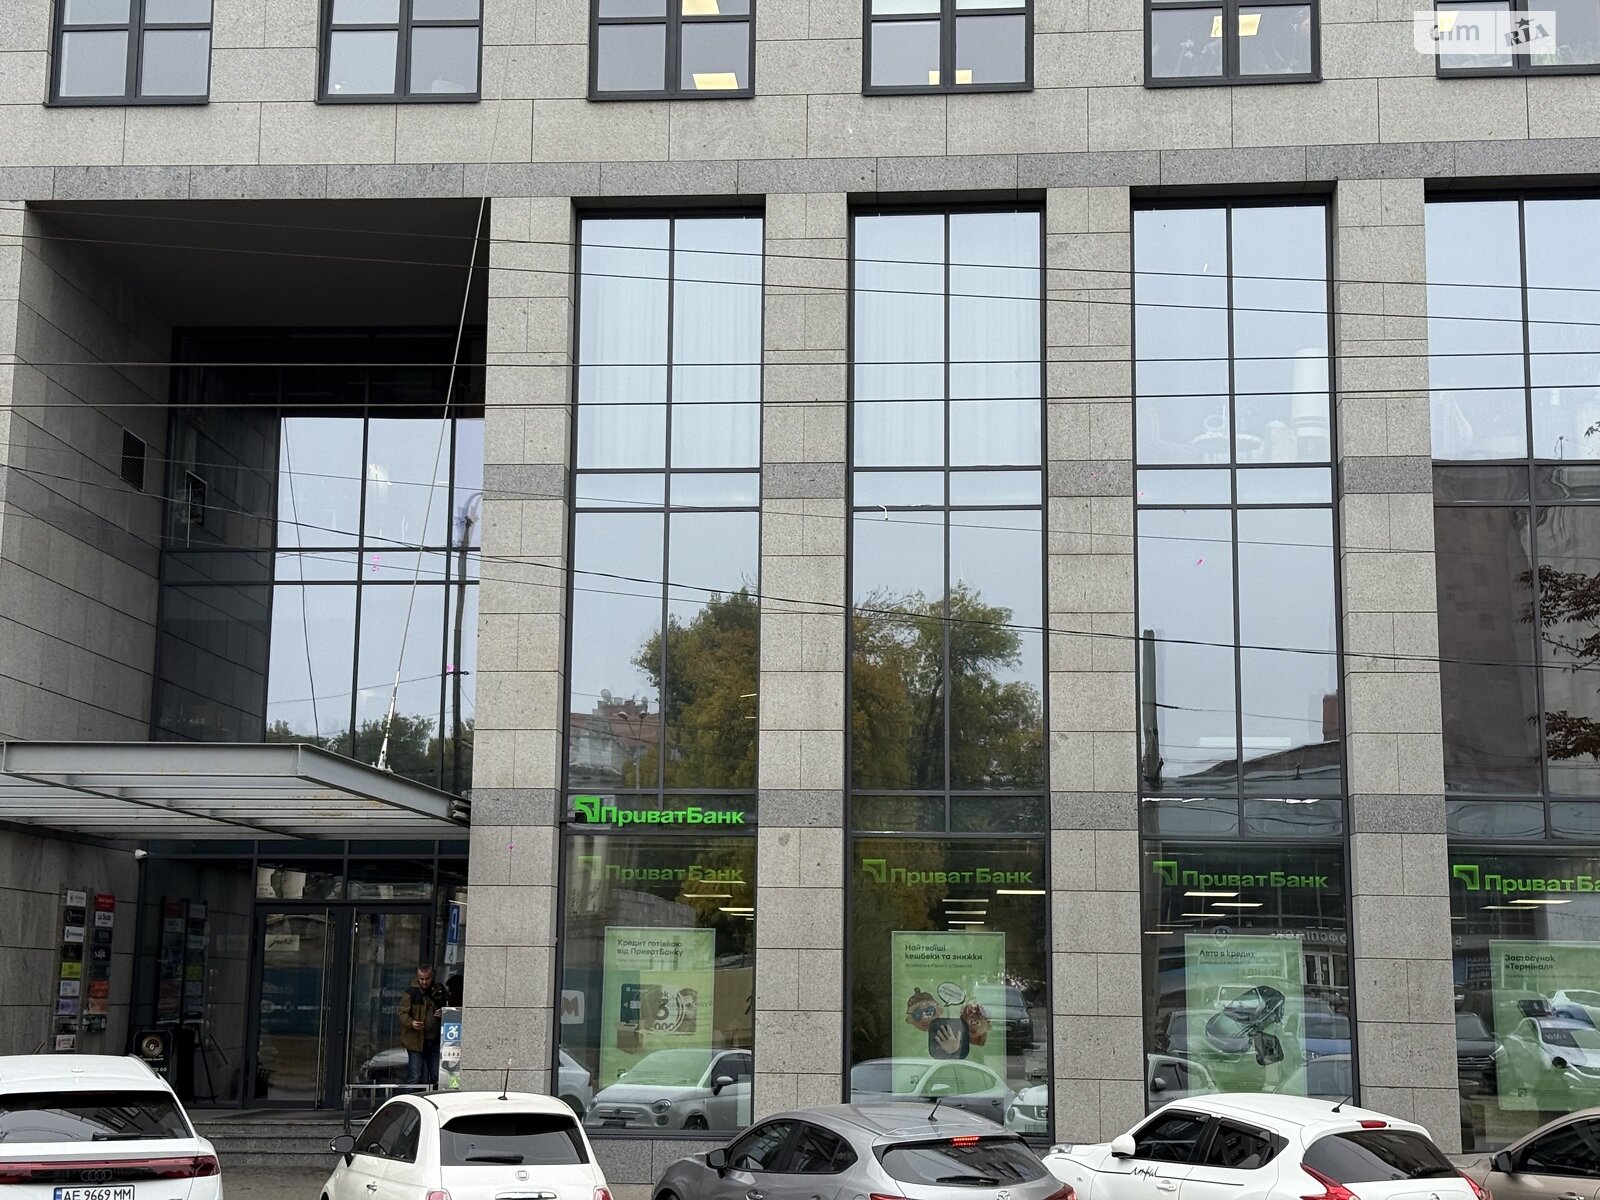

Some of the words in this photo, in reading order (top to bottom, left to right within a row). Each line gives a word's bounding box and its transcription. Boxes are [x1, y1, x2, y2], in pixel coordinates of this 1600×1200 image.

[601, 806, 745, 827] ПриватБанк
[891, 868, 1032, 886] ПриватБанк
[1182, 870, 1329, 889] ПриватБанк
[617, 939, 646, 949] Кредит
[905, 944, 946, 952] Найтвоїші
[1199, 949, 1219, 957] Авто
[1504, 954, 1556, 963] Застосунок
[1505, 963, 1554, 971] «Термінал»
[64, 1190, 81, 1200] AE
[84, 1189, 111, 1200] 9669
[114, 1189, 132, 1200] MM
